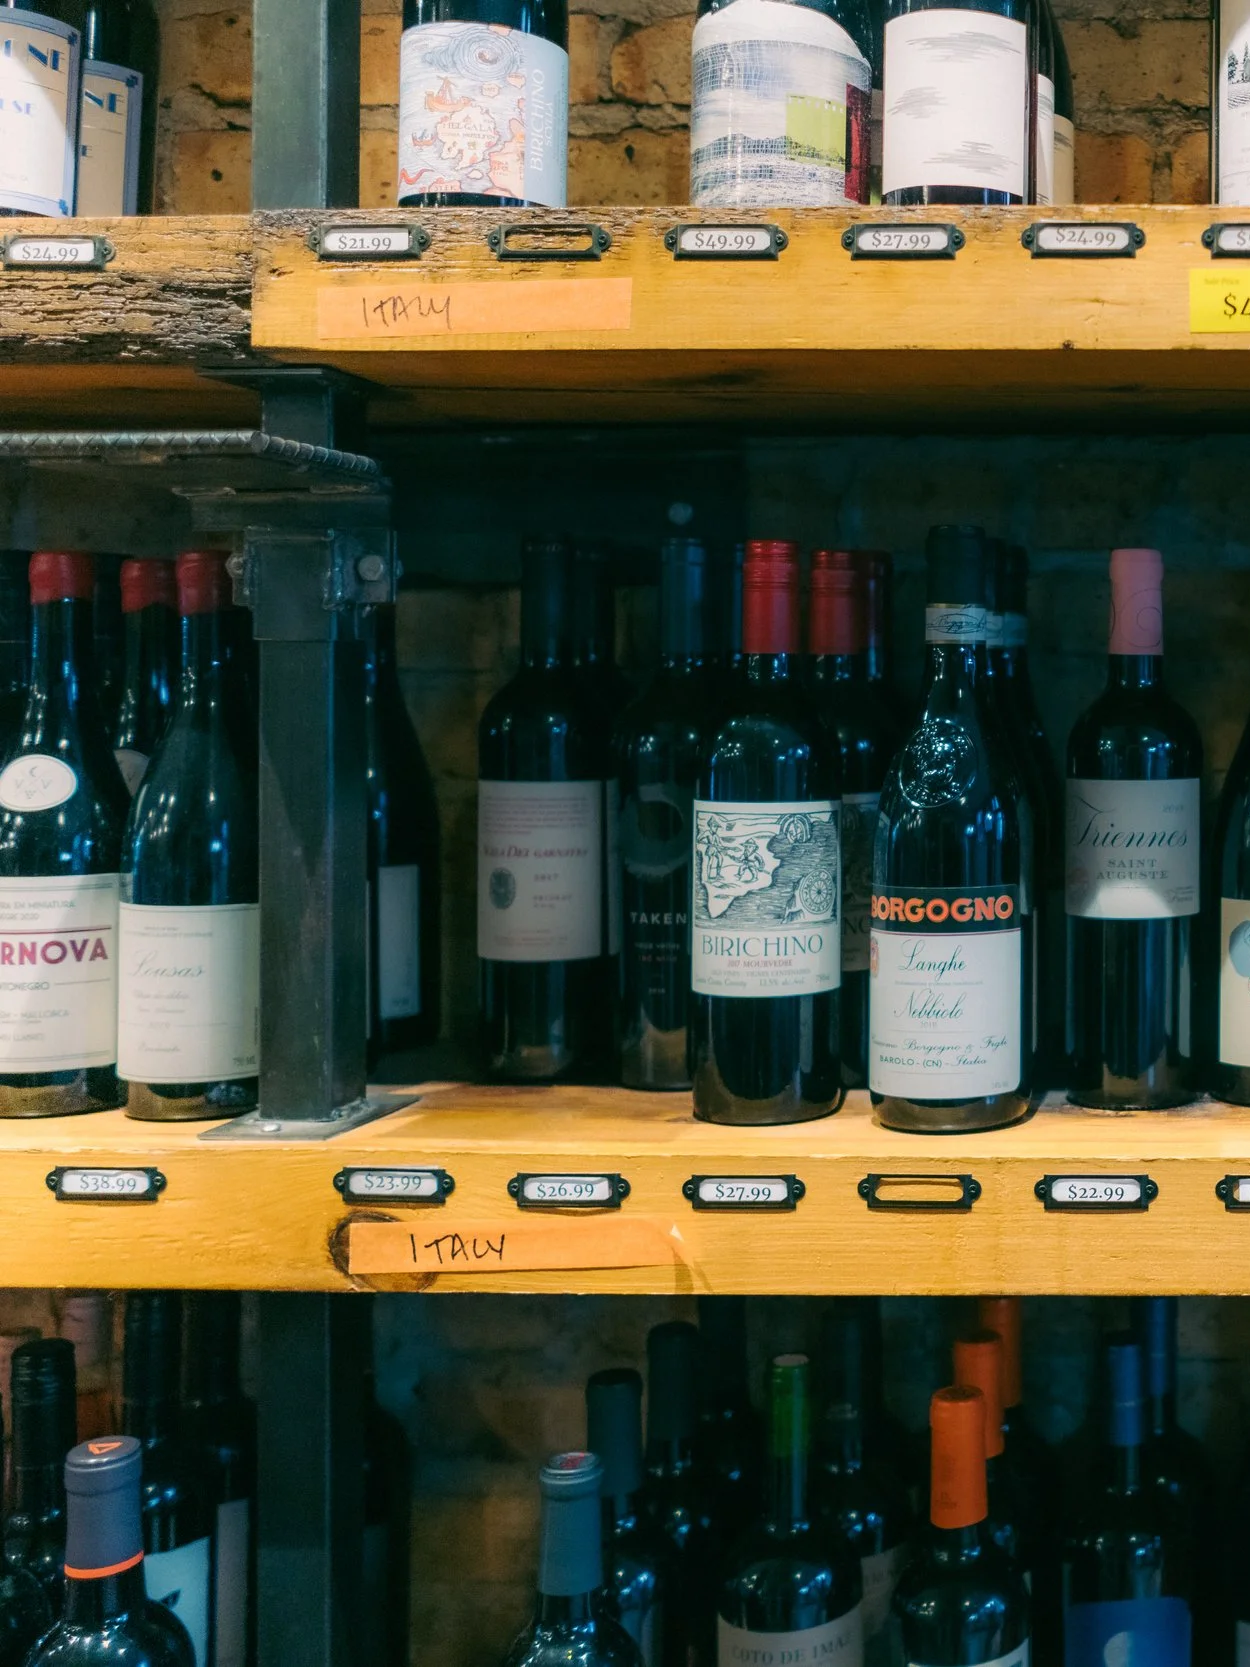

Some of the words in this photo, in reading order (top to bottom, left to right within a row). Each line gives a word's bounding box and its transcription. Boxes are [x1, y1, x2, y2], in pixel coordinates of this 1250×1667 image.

[529, 69, 545, 171] BIRICHINO
[338, 233, 392, 252] $21.99
[695, 231, 755, 249] $49.99
[872, 230, 931, 249] $27.99
[1056, 227, 1117, 247] $24.99
[22, 244, 79, 262] $24.99
[362, 295, 452, 331] ITALY
[1073, 795, 1188, 848] Triennes
[1107, 859, 1157, 868] SAINT
[1096, 870, 1169, 880] AUGUSTE
[630, 911, 687, 925] TAKEN
[871, 894, 1014, 923] BORGOGNO
[702, 933, 823, 957] BIRICHINO
[898, 938, 967, 982] Langhe
[894, 987, 968, 1020] Nebbiolo
[902, 1038, 961, 1055] Borgogno
[879, 1055, 915, 1066] BAROLO
[922, 1058, 943, 1069] (CN)
[951, 1054, 987, 1067] Italia
[80, 1174, 137, 1192] $38.99
[364, 1173, 422, 1192] $23.99
[537, 1181, 595, 1200] $26.99
[715, 1183, 772, 1201] $27.99
[1068, 1183, 1124, 1201] $22.99
[410, 1233, 505, 1263] ITALY
[780, 1648, 804, 1665] DE
